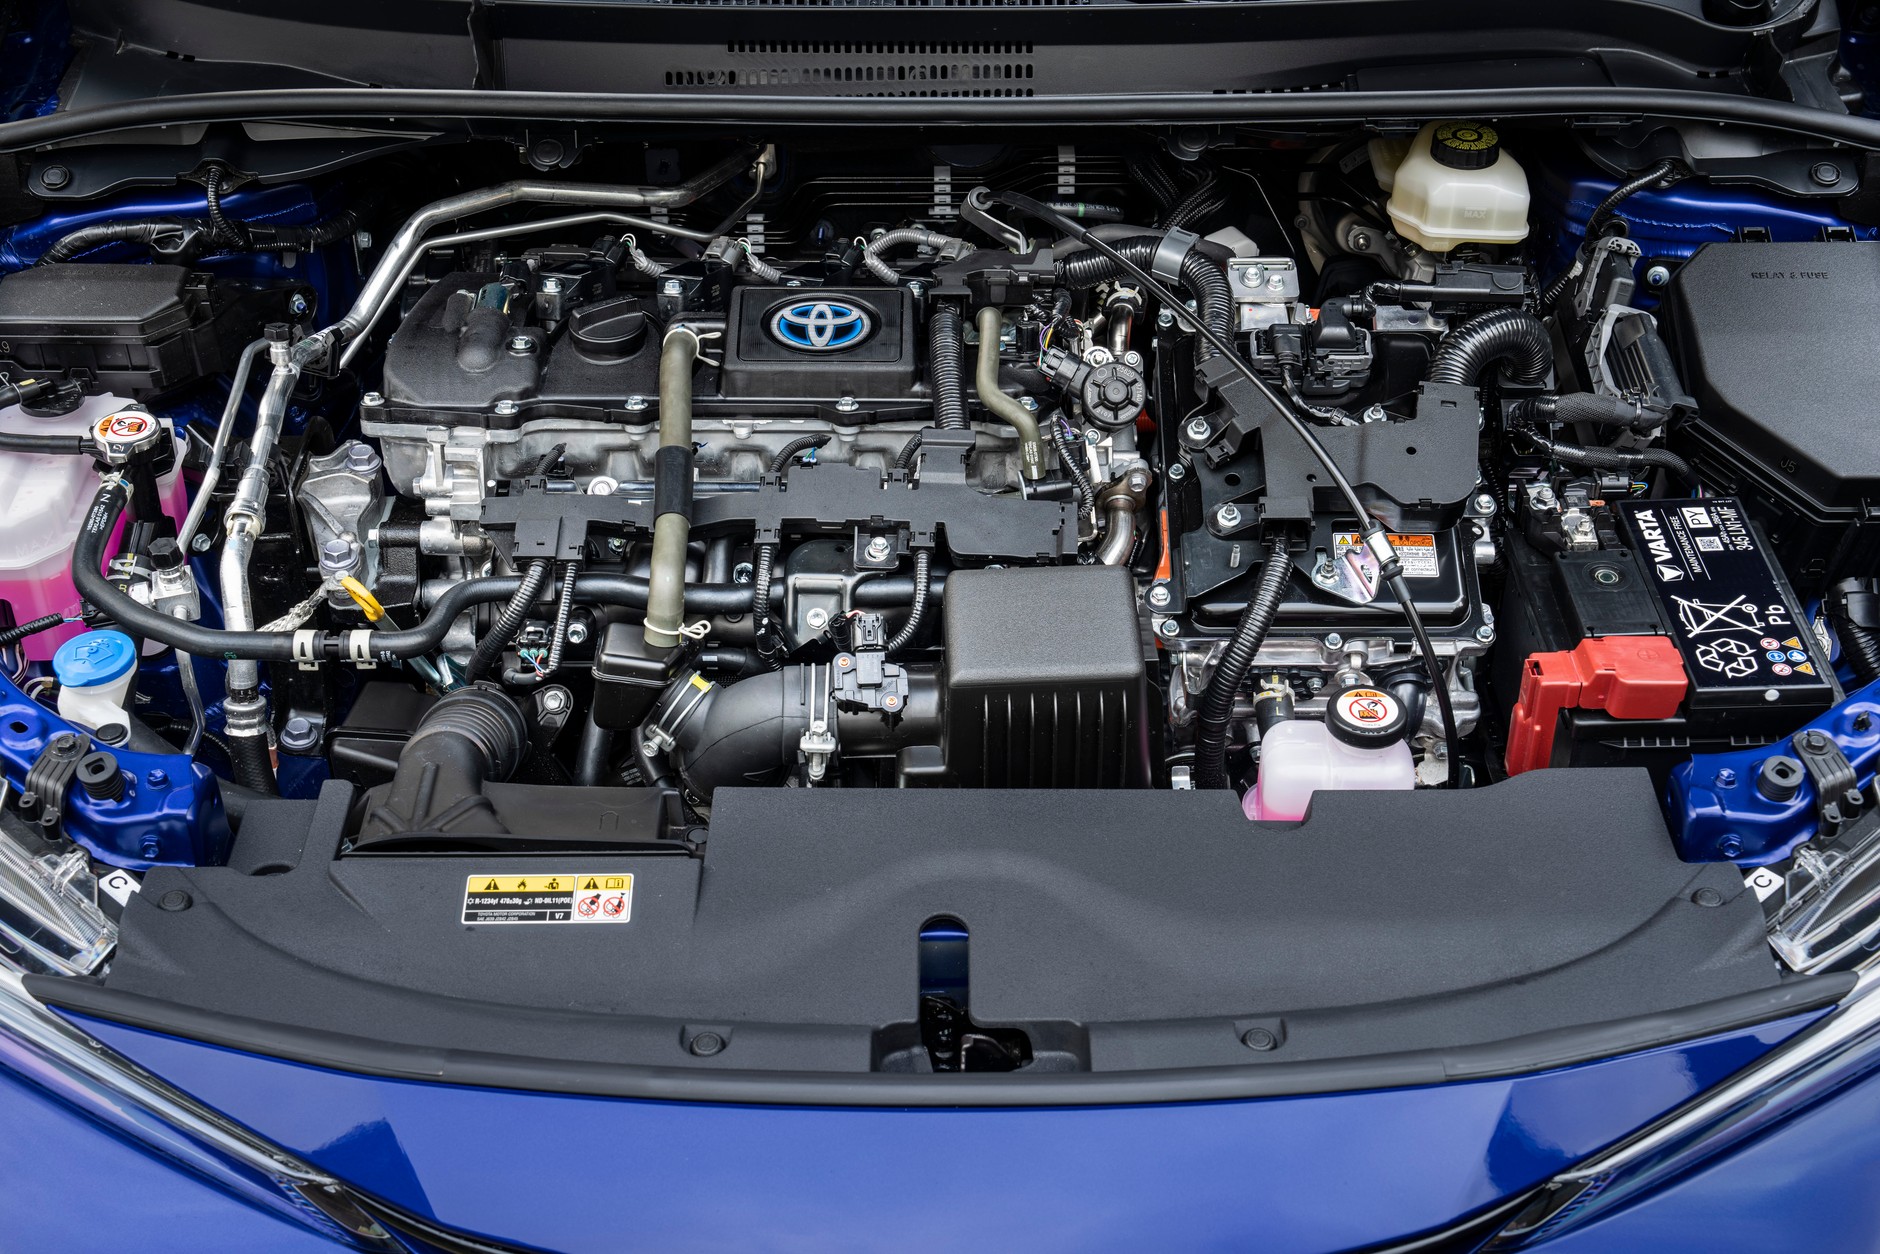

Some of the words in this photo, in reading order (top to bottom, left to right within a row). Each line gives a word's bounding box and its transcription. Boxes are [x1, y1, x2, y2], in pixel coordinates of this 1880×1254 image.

[1463, 210, 1487, 219] MAX
[1751, 271, 1785, 280] RELAY
[1800, 271, 1829, 280] FUSE
[1116, 365, 1135, 377] 25620
[1669, 515, 1682, 530] FREE
[1686, 509, 1709, 525] PY
[1717, 506, 1747, 535] LN1-MF
[1635, 509, 1673, 563] VARTA
[1731, 536, 1754, 551] 345
[1675, 530, 1702, 573] MAINTENANCE
[1765, 604, 1791, 625] Pb
[108, 875, 128, 889] C
[1753, 874, 1773, 888] C
[555, 912, 564, 920] V7
